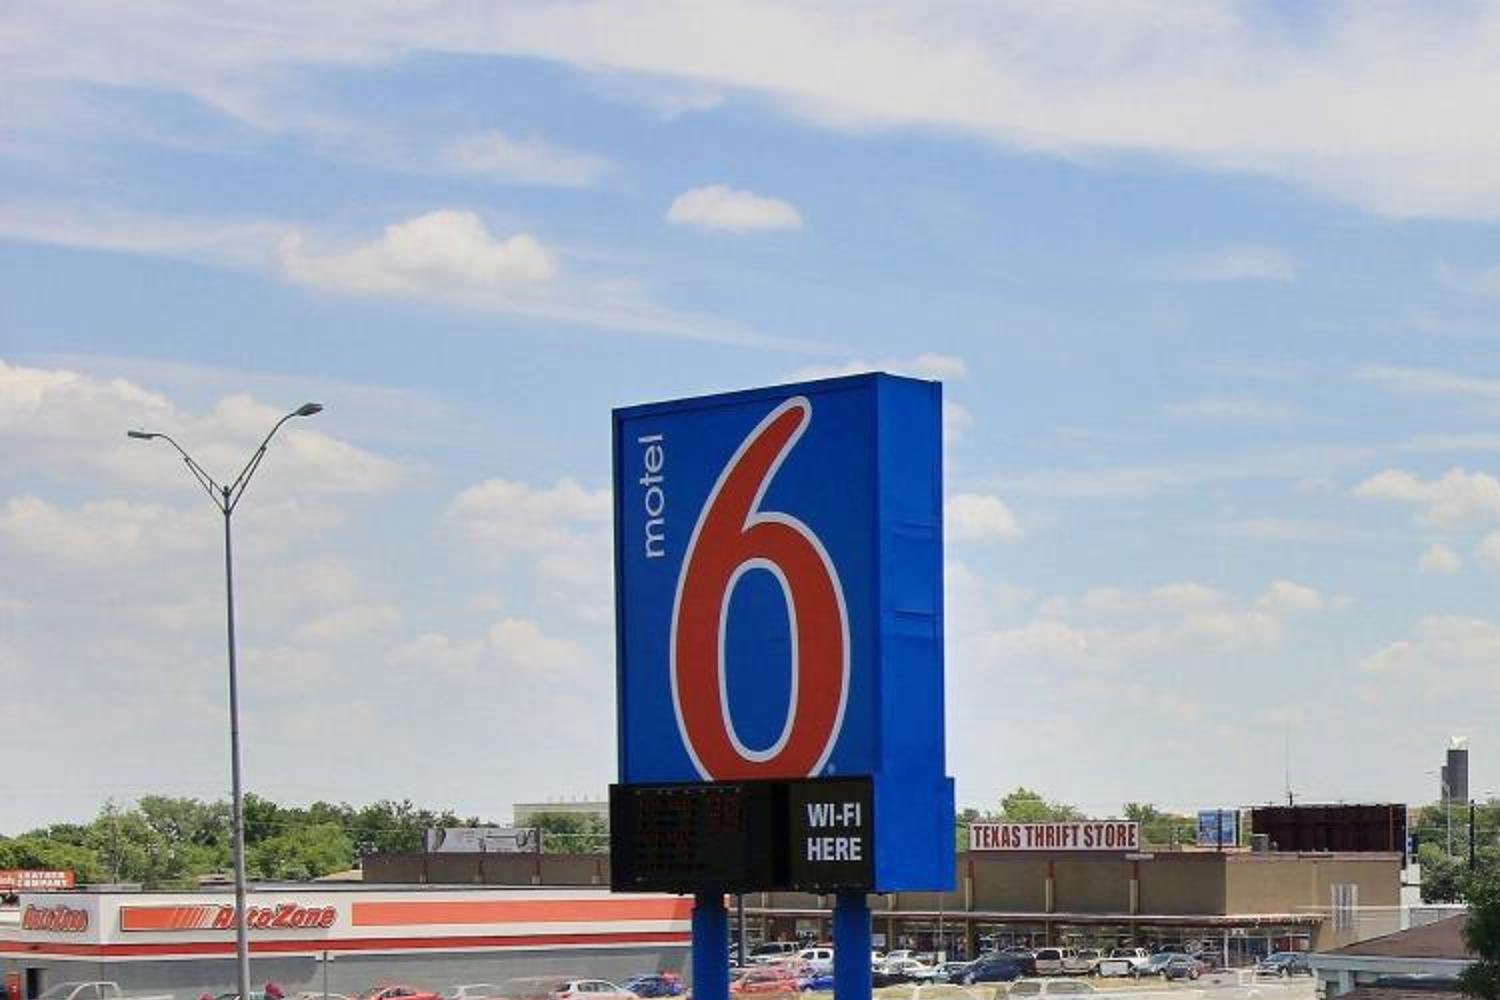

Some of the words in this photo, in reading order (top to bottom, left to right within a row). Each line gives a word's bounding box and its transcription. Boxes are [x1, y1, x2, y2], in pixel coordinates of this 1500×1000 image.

[638, 434, 665, 558] motel
[670, 395, 852, 782] 6
[806, 801, 862, 828] WI-FI
[806, 836, 862, 861] HERE
[973, 825, 1021, 848] TEXAS
[1025, 825, 1080, 848] THRIFT
[1083, 824, 1137, 848] STORE
[213, 903, 337, 929] AtoZone
